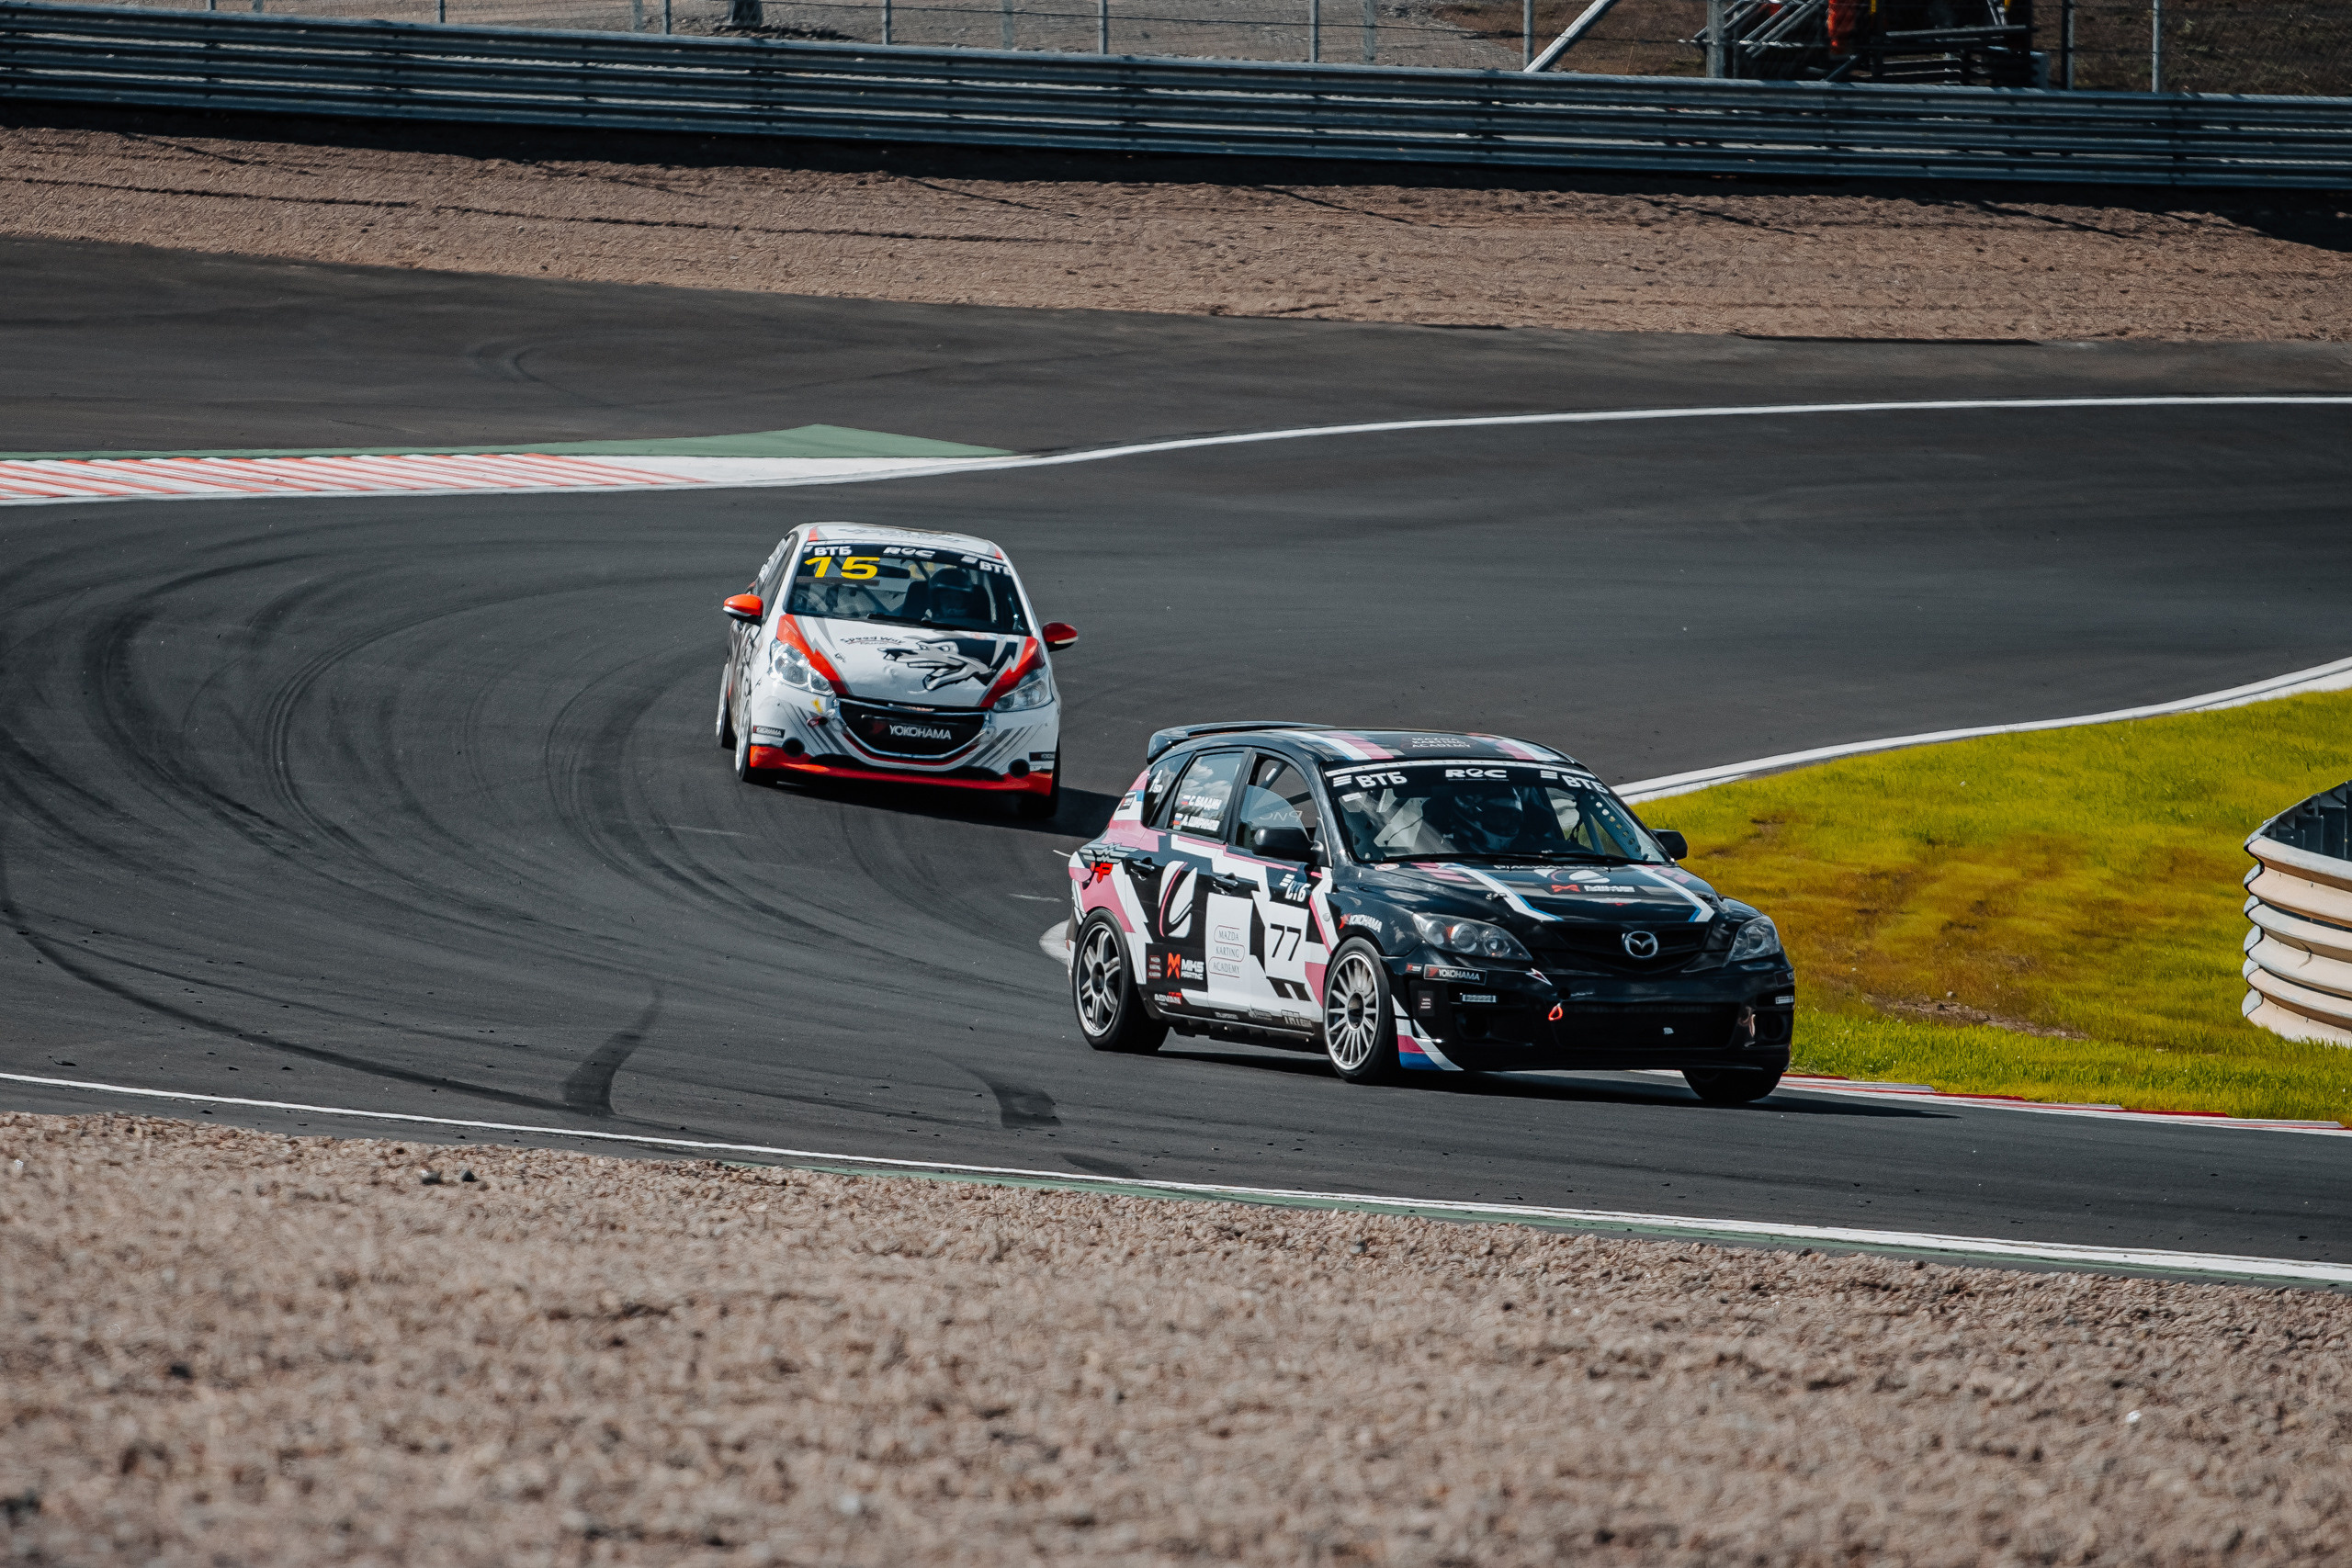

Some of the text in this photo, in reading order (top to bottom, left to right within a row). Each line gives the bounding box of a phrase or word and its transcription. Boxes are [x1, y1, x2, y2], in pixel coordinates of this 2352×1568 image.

[814, 546, 852, 557] ВТБ
[804, 556, 880, 580] 15
[889, 724, 952, 740] YOKOHAMA
[1355, 771, 1408, 788] ВТБ
[1561, 774, 1609, 795] ВТБ
[1284, 879, 1311, 903] ВТБ
[1349, 914, 1383, 933] YOKOHAMA
[1218, 930, 1239, 942] MAZDA
[1270, 923, 1301, 961] 77
[1216, 946, 1239, 958] KARTING
[1213, 962, 1240, 975] ACADEMY
[1439, 968, 1480, 981] YOKOHAMA
